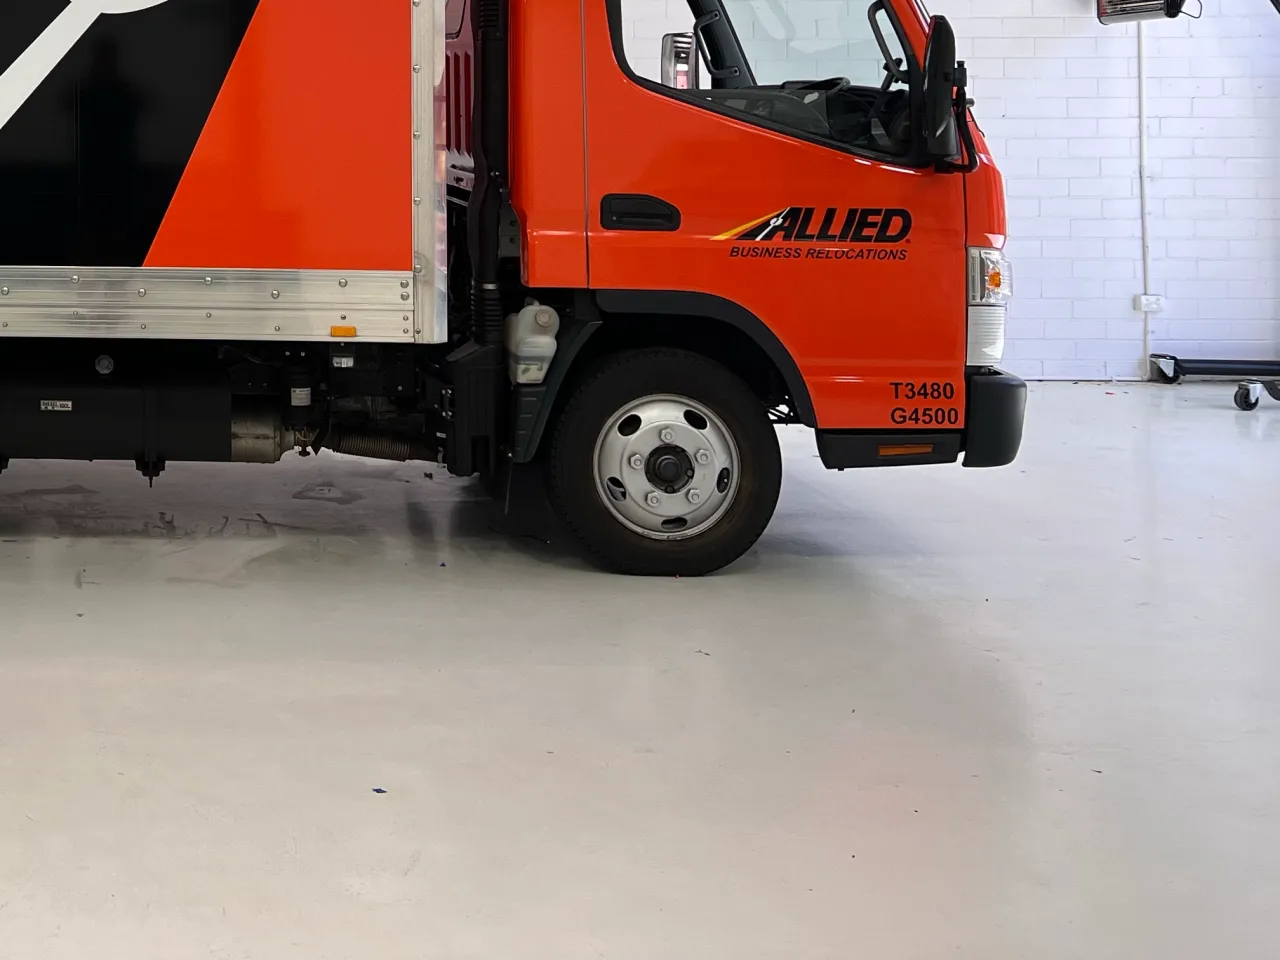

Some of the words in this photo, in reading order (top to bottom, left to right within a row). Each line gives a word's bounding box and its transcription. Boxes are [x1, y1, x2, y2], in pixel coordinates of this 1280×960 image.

[735, 207, 913, 243] ALLIED
[729, 247, 801, 259] BUSINESS
[805, 248, 908, 260] RELOCATIONS
[890, 382, 954, 400] T3480
[890, 407, 959, 426] G4500
